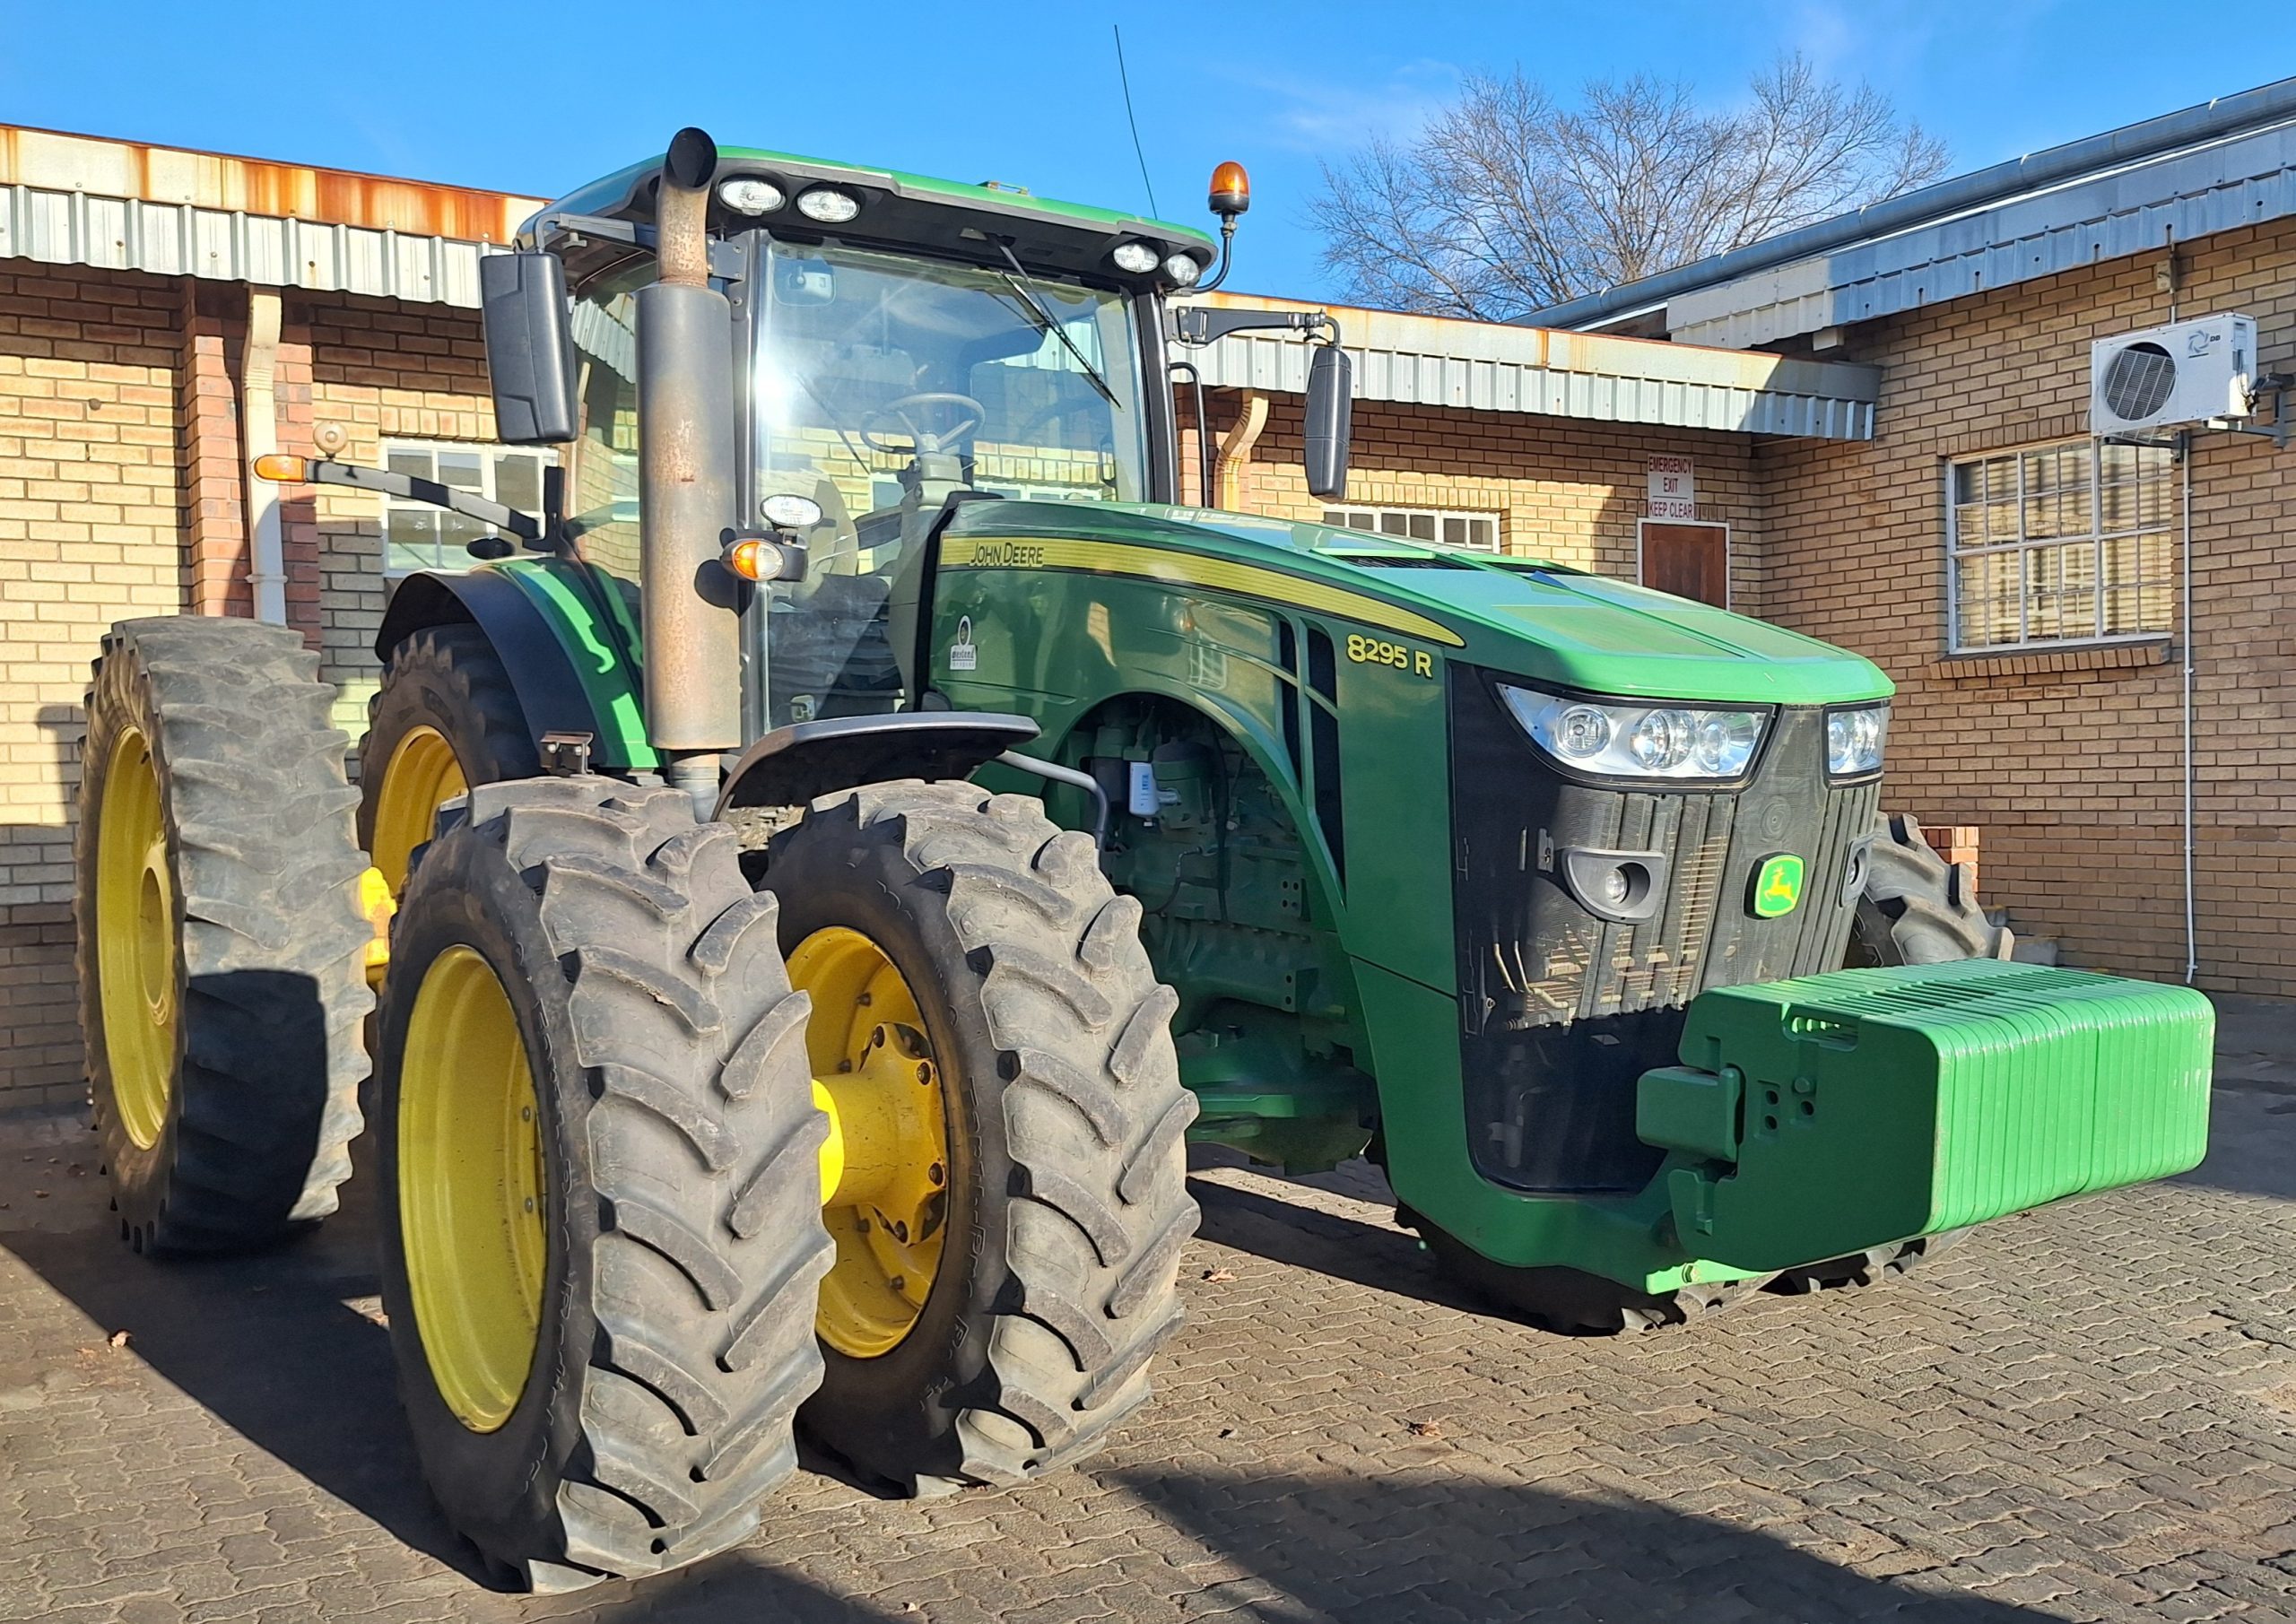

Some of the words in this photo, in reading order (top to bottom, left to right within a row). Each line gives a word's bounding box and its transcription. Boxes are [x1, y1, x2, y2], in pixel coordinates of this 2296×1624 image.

[1648, 456, 1692, 473] EMERGENCY
[1663, 477, 1679, 493] EXIT
[1649, 501, 1667, 517] KEEP
[1669, 502, 1693, 519] CLEAR
[970, 542, 1002, 565] JOHN
[1003, 542, 1045, 566] DEERE
[1346, 633, 1409, 670] 8295
[1413, 650, 1434, 679] R
